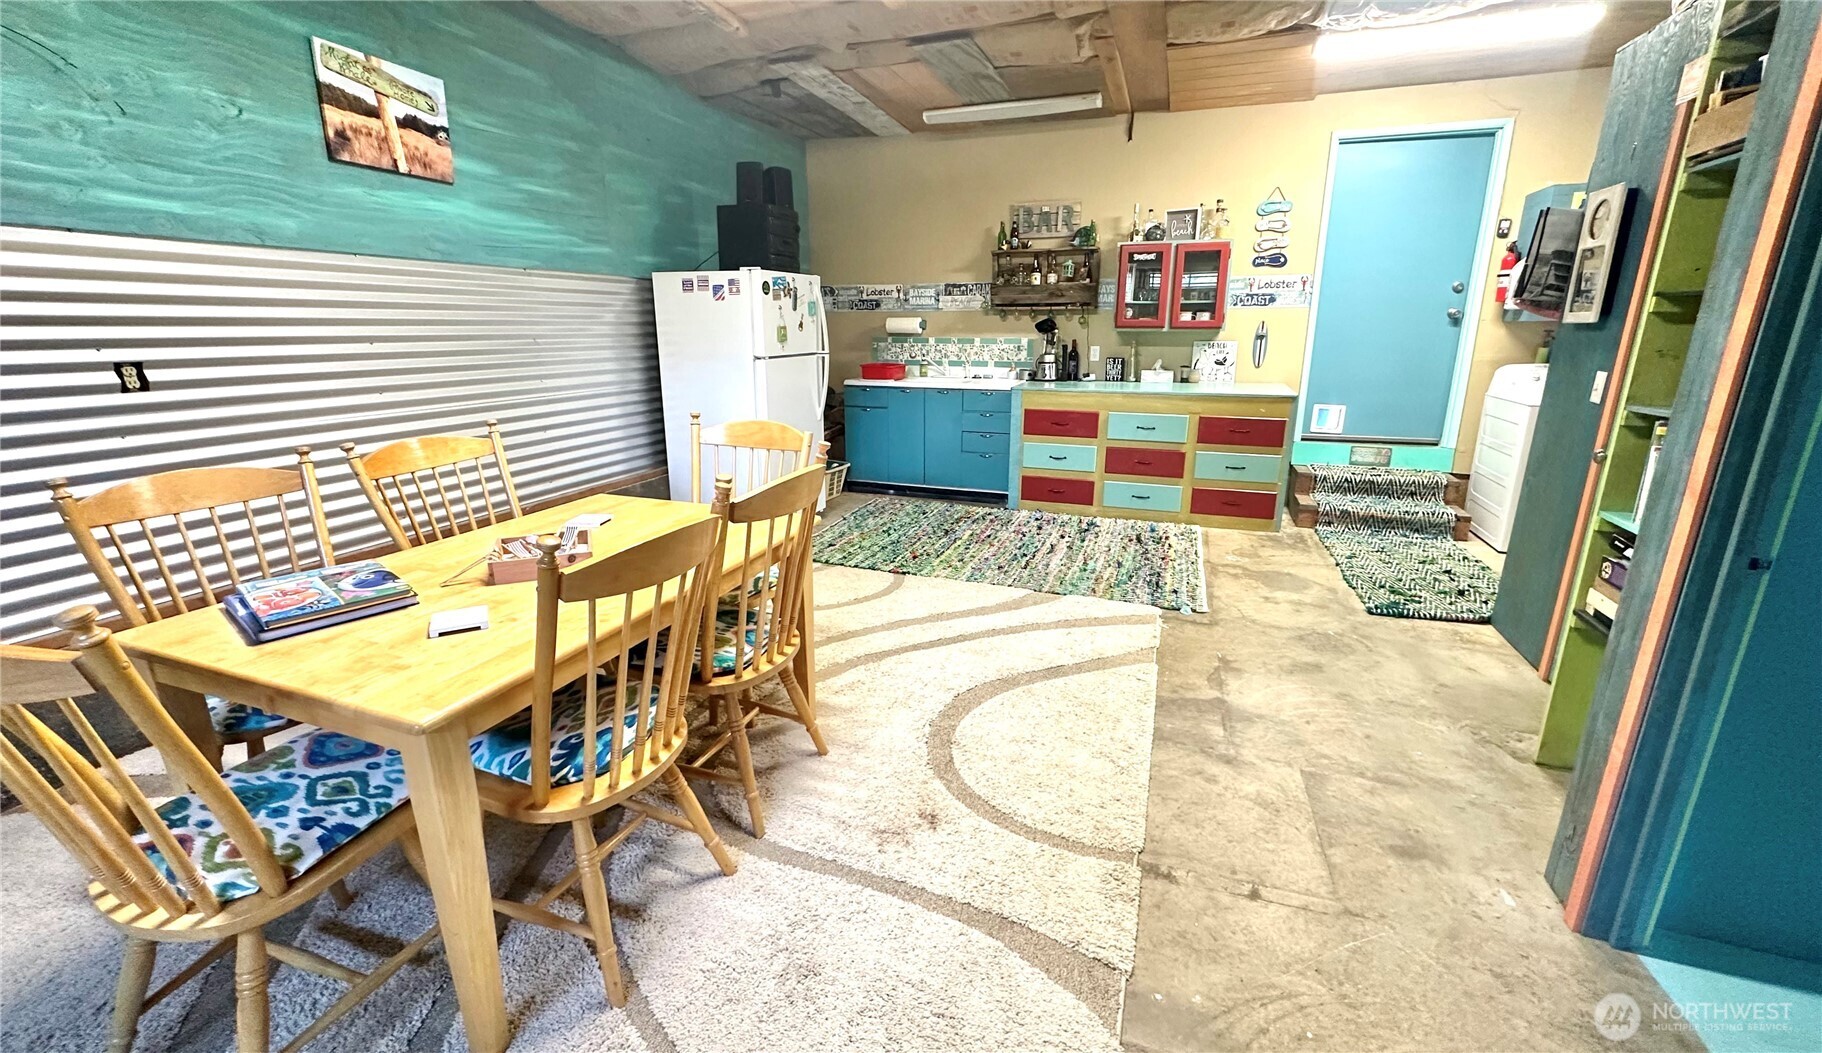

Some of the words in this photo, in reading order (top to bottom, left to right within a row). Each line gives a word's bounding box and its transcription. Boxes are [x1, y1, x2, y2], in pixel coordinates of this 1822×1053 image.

[1018, 205, 1074, 234] BAR
[1171, 220, 1195, 238] beach
[1257, 279, 1297, 290] Lobster
[866, 287, 895, 297] Lobster
[909, 288, 936, 297] BAYSIDE
[967, 284, 991, 297] CABAN
[852, 301, 877, 310] COAST
[909, 297, 936, 305] MARINA
[1237, 295, 1271, 306] COAST
